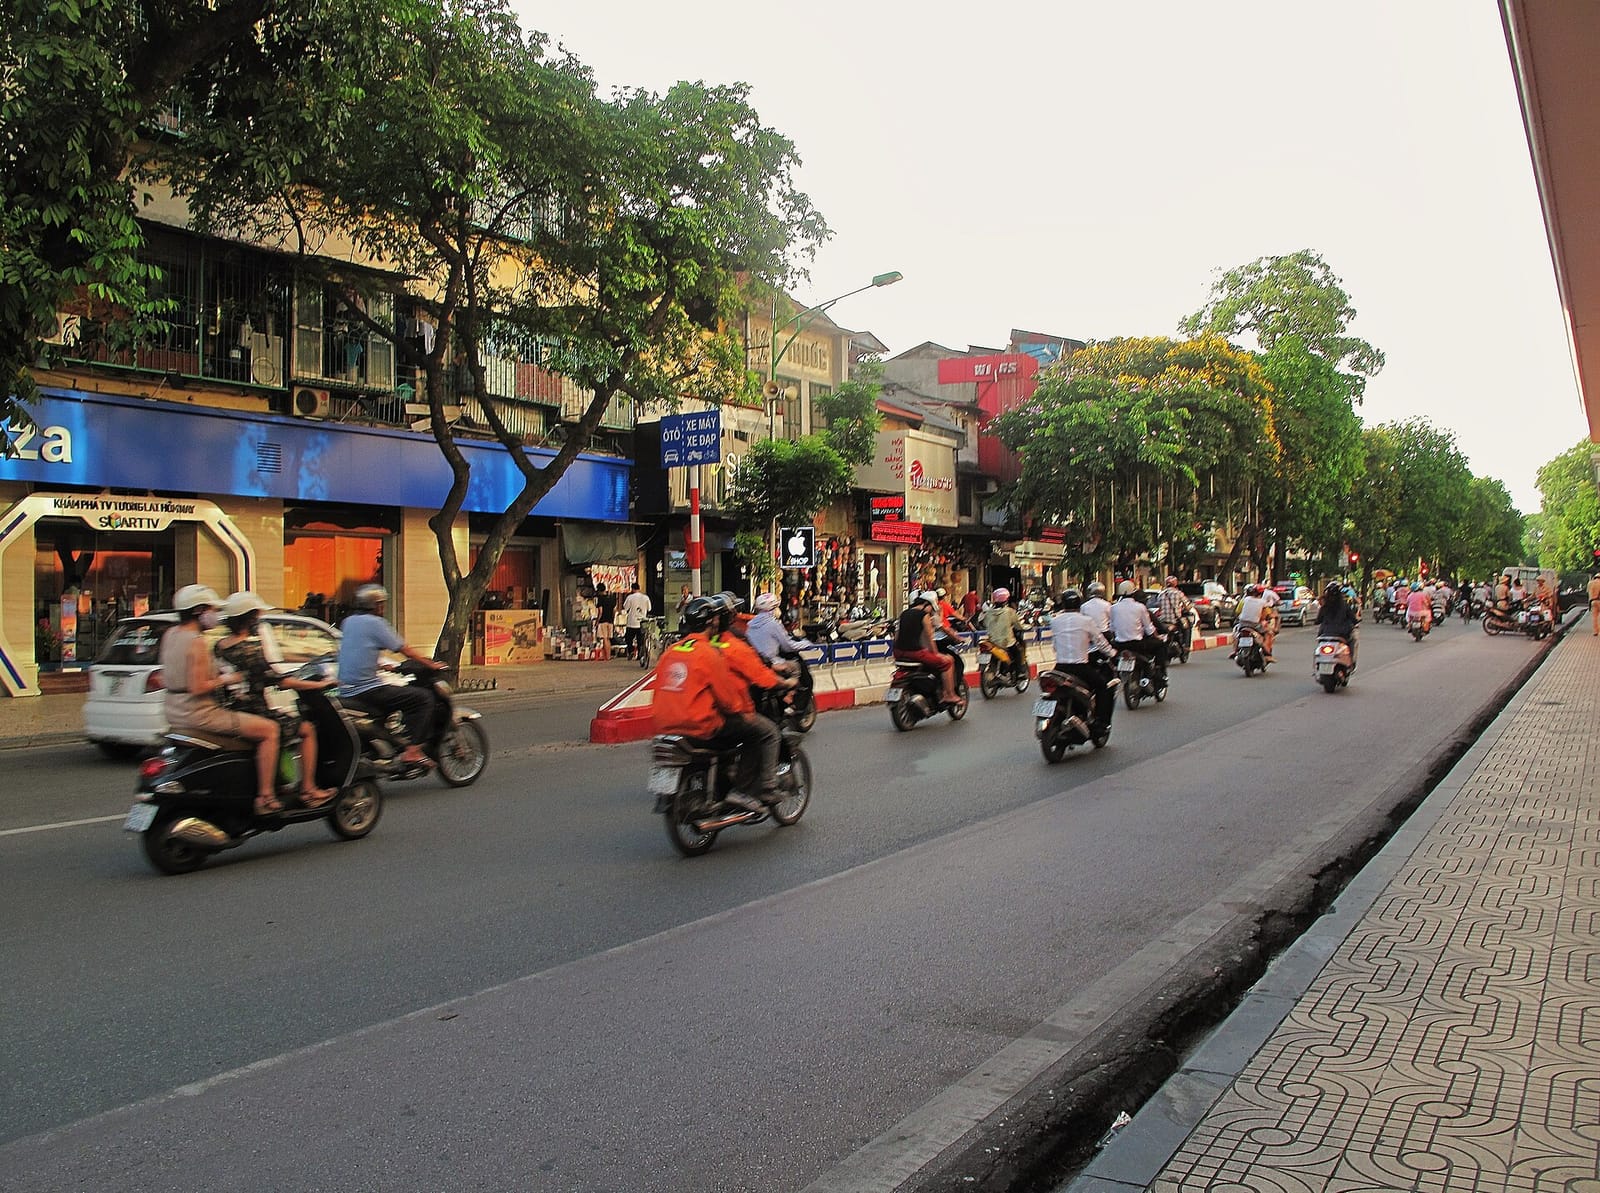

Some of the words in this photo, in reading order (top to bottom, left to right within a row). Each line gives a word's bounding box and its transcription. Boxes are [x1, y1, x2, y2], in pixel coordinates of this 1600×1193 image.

[686, 419, 697, 431] XE
[698, 415, 716, 430] MÁY
[663, 426, 681, 442] ÔTÔ
[686, 434, 698, 447] XE
[699, 433, 717, 448] ĐẠP
[99, 500, 112, 511] TV
